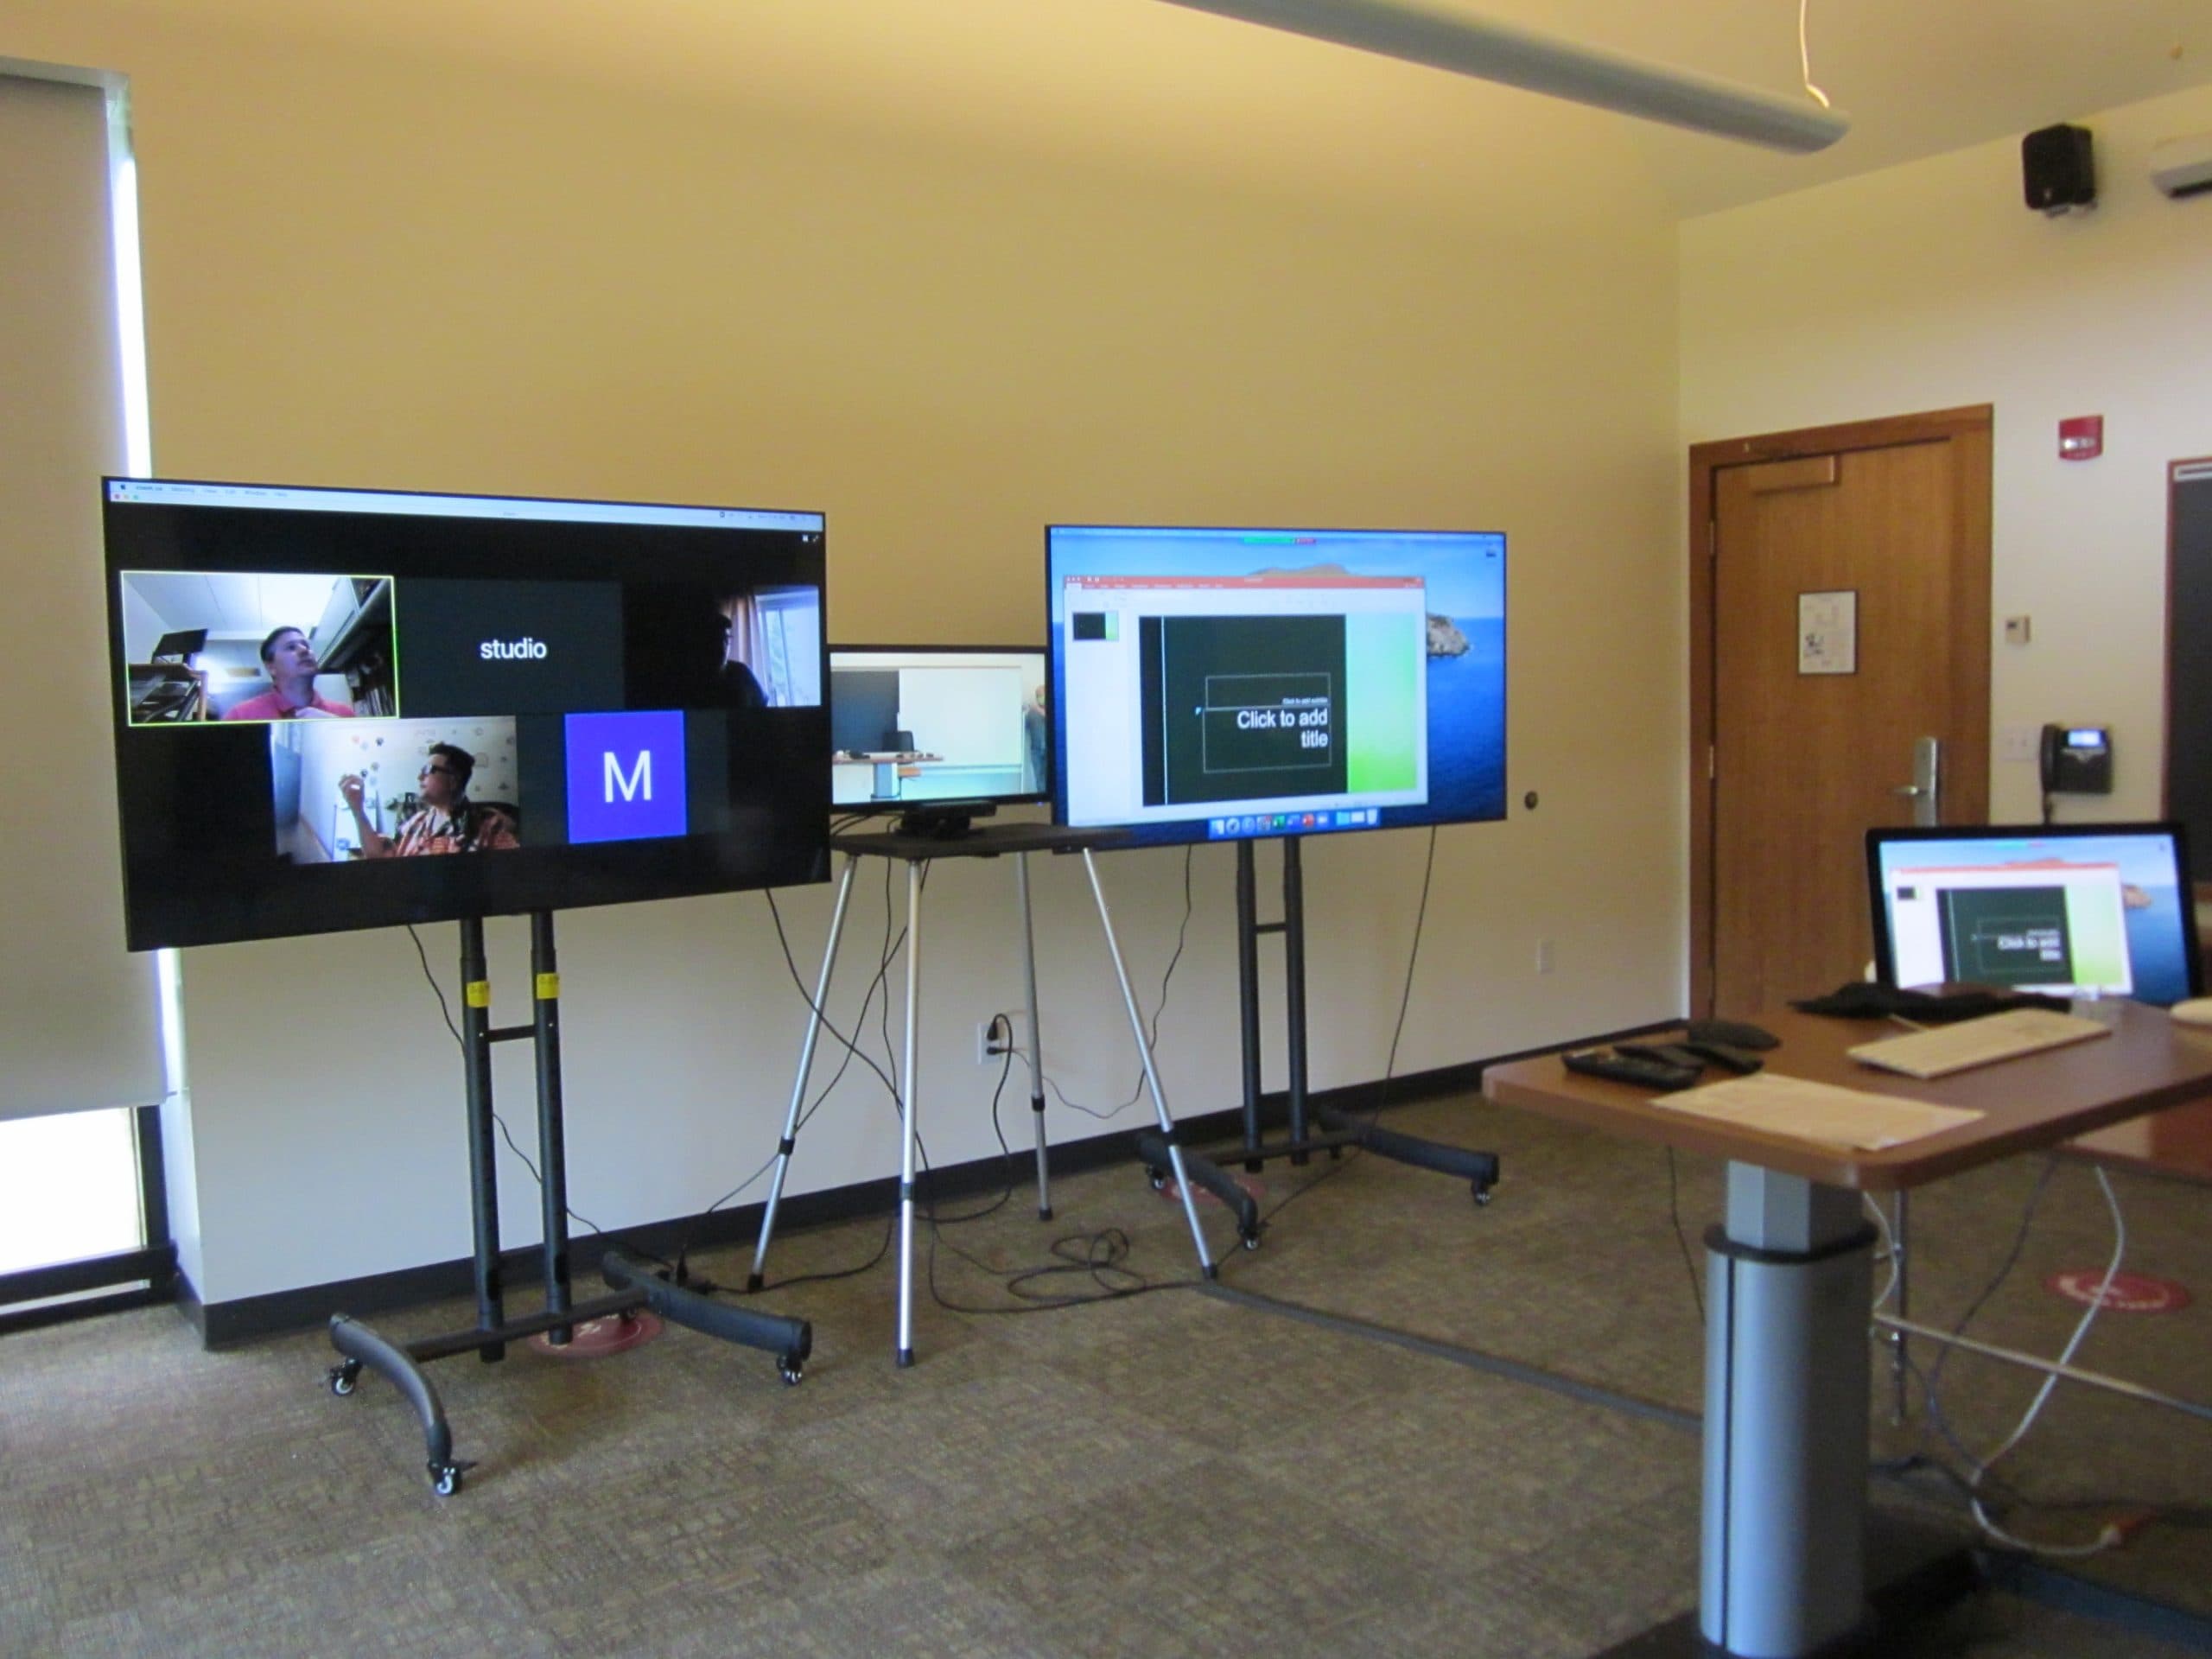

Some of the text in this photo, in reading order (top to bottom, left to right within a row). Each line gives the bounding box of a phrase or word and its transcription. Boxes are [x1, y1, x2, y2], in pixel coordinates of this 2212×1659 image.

[480, 637, 547, 659] studio
[1236, 709, 1328, 729] Click to add
[1300, 729, 1328, 748] title
[604, 750, 652, 803] M
